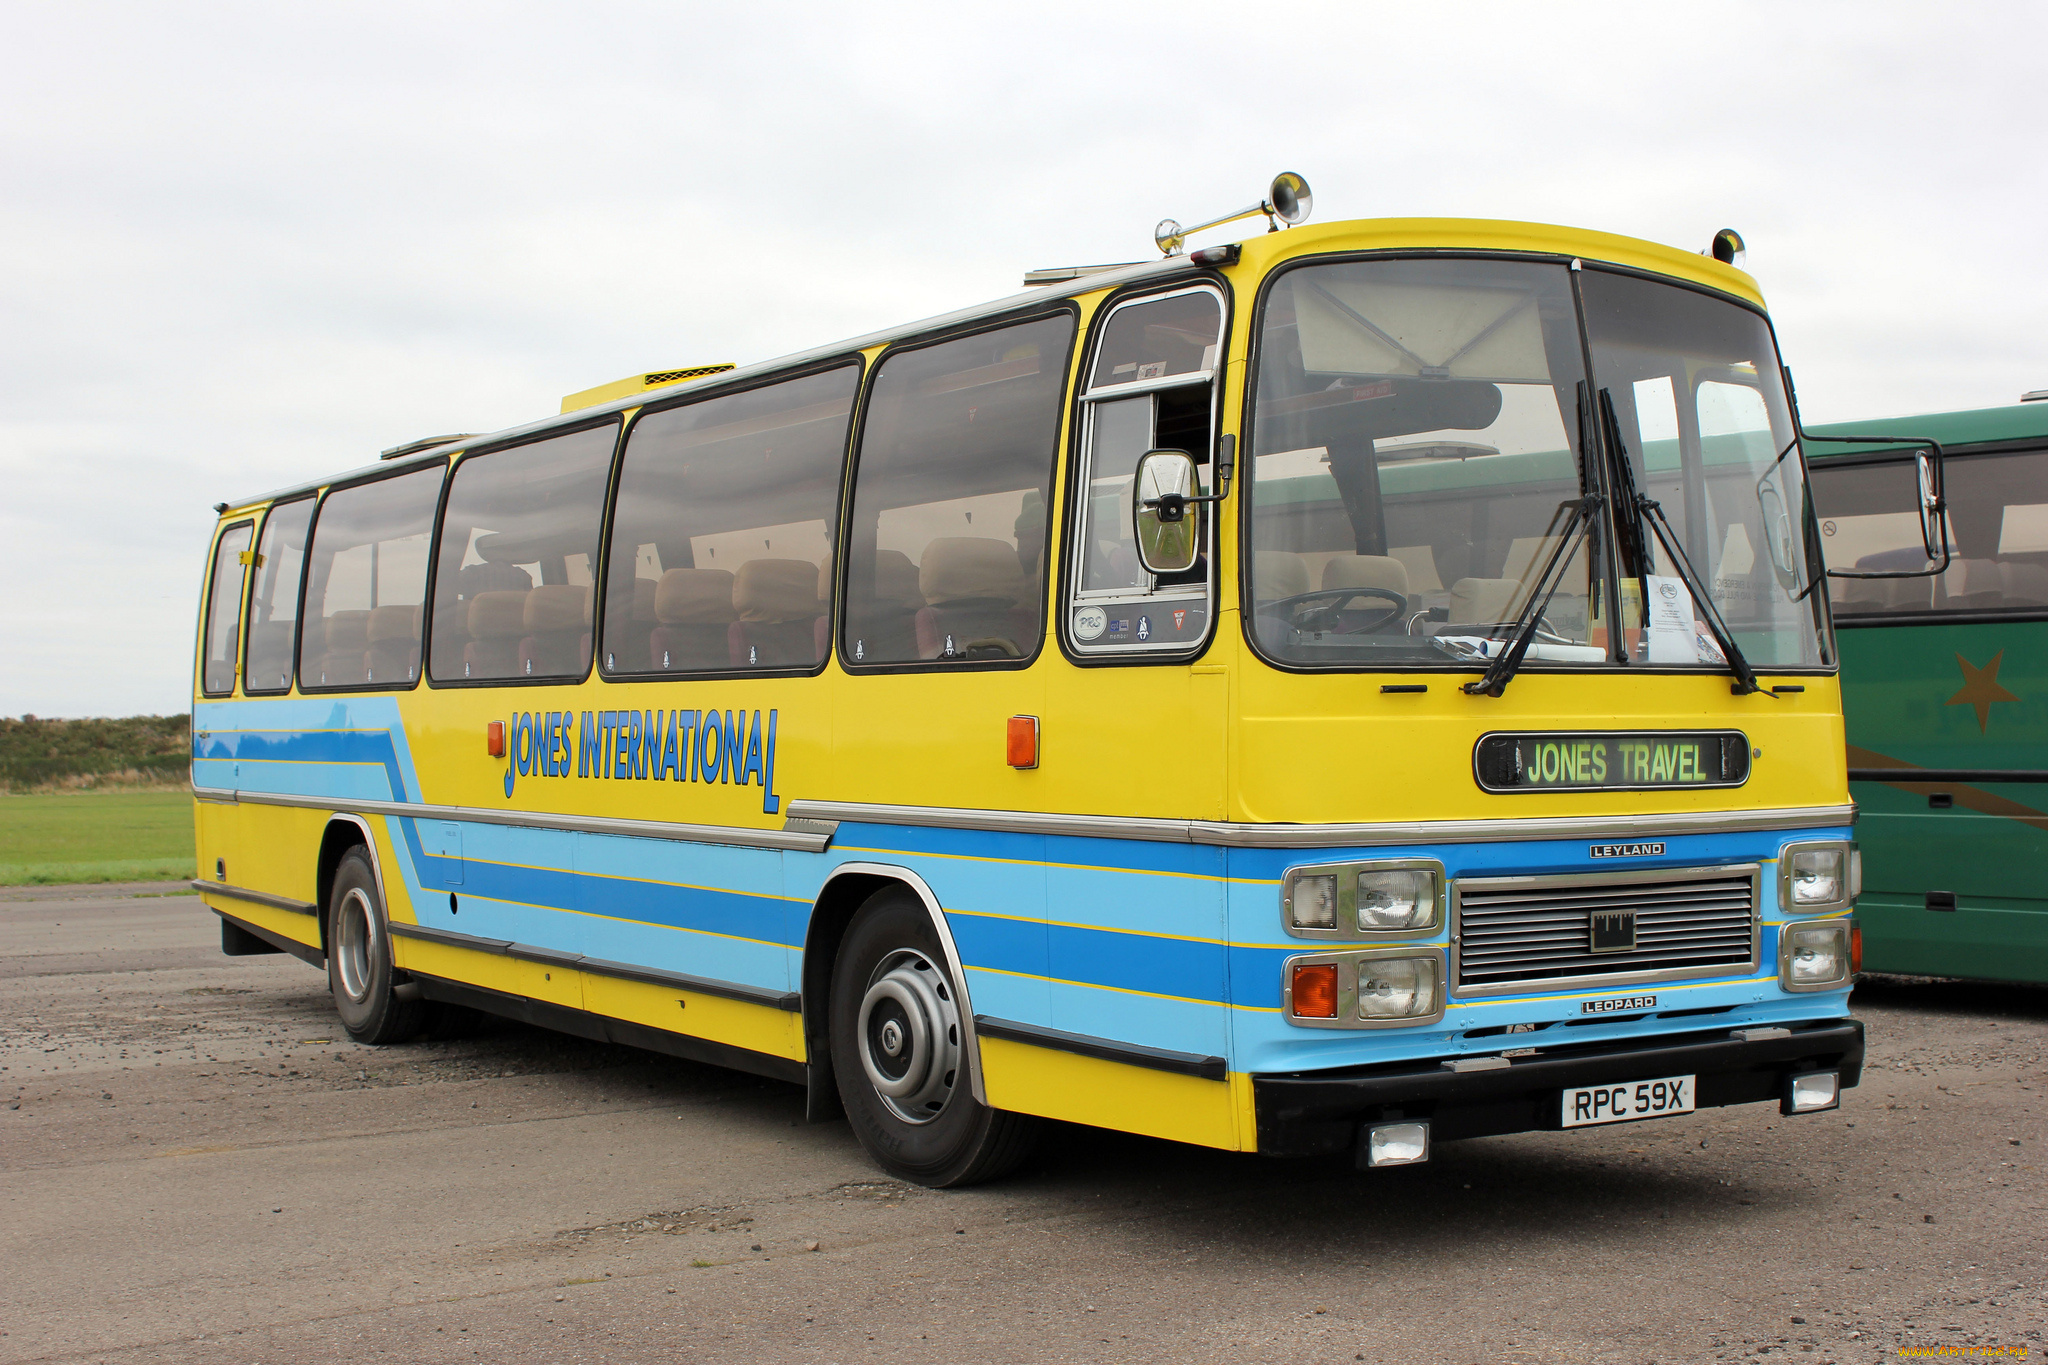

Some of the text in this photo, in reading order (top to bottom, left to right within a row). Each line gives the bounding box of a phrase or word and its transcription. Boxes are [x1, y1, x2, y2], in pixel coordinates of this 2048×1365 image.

[1079, 616, 1101, 629] PRS
[504, 709, 780, 814] JONES INTERNATIONAL
[1528, 743, 1707, 782] JONES TRAVEL
[1594, 844, 1662, 857] LEYLAND
[1585, 996, 1655, 1013] LEOPARD
[1575, 1080, 1684, 1121] RPC 59X
